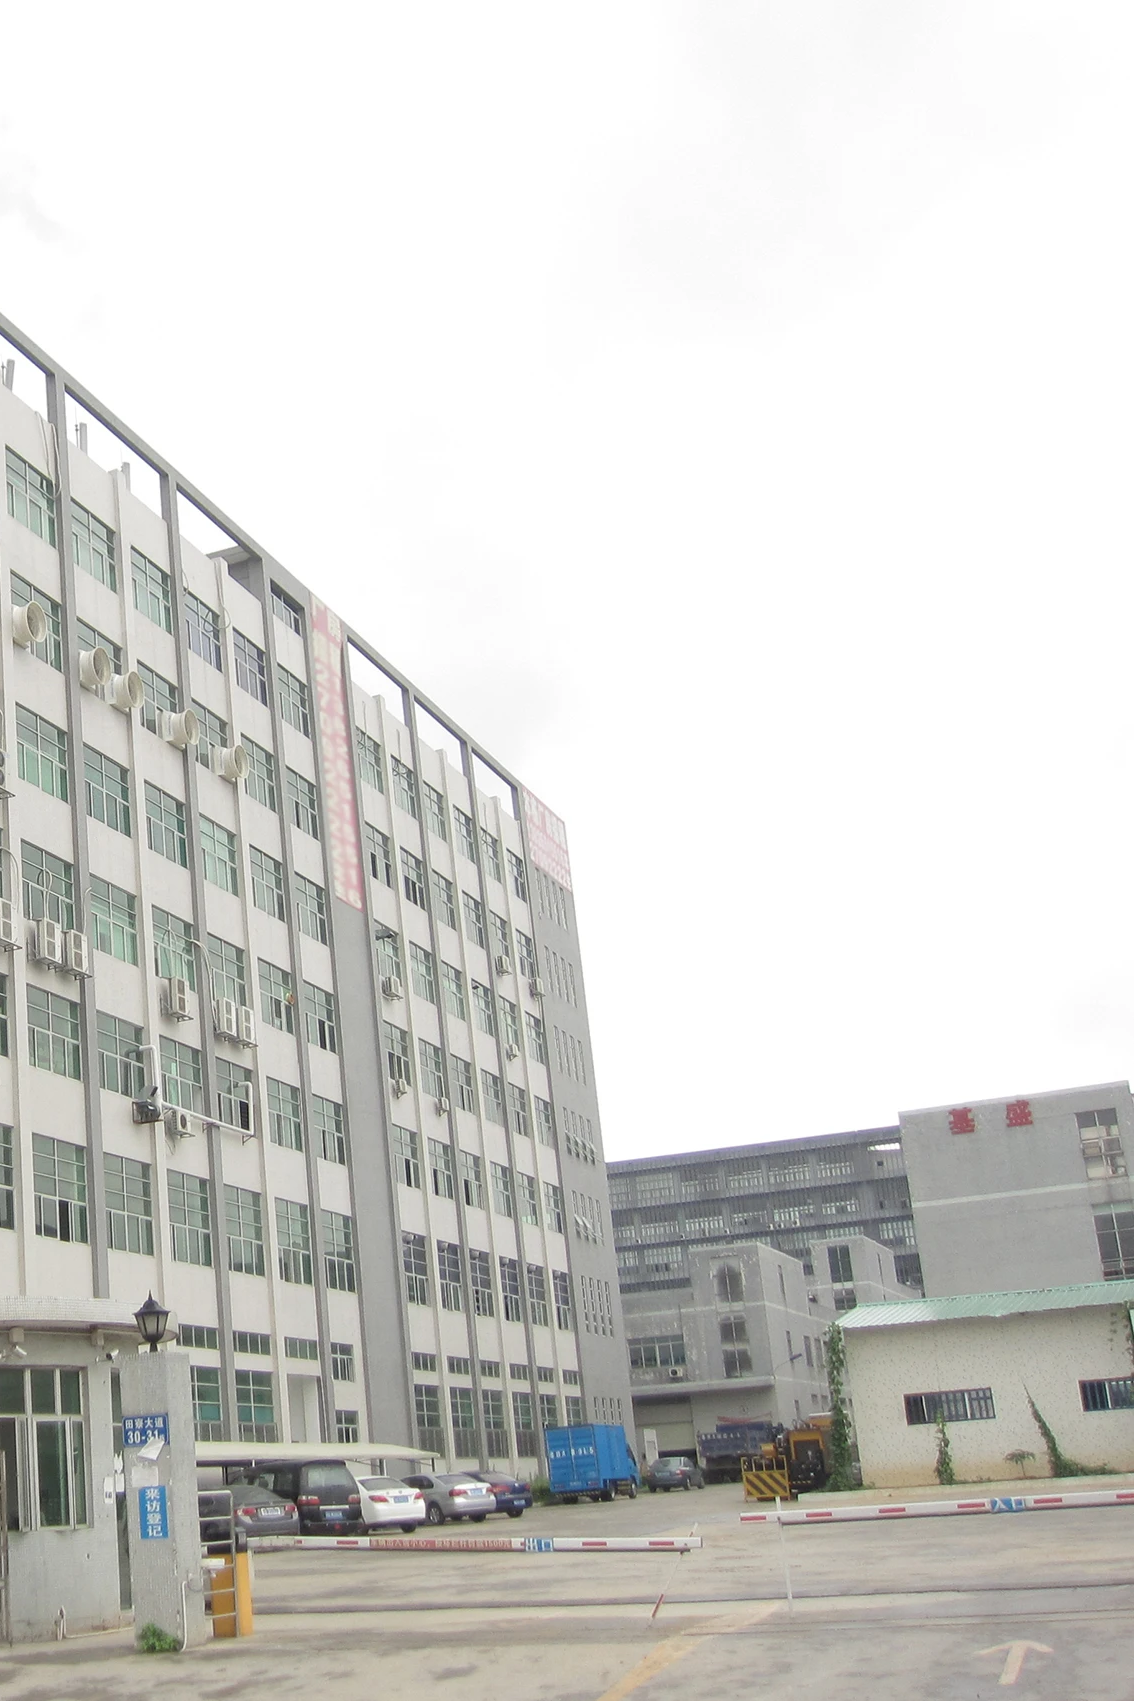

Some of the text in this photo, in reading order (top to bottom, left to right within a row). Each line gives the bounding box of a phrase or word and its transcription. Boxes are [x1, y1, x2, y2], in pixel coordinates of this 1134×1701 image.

[125, 1417, 164, 1429] 田寮大道
[993, 1497, 1025, 1511] 入口
[145, 1488, 163, 1537] 来访登记
[526, 1537, 553, 1551] 出口
